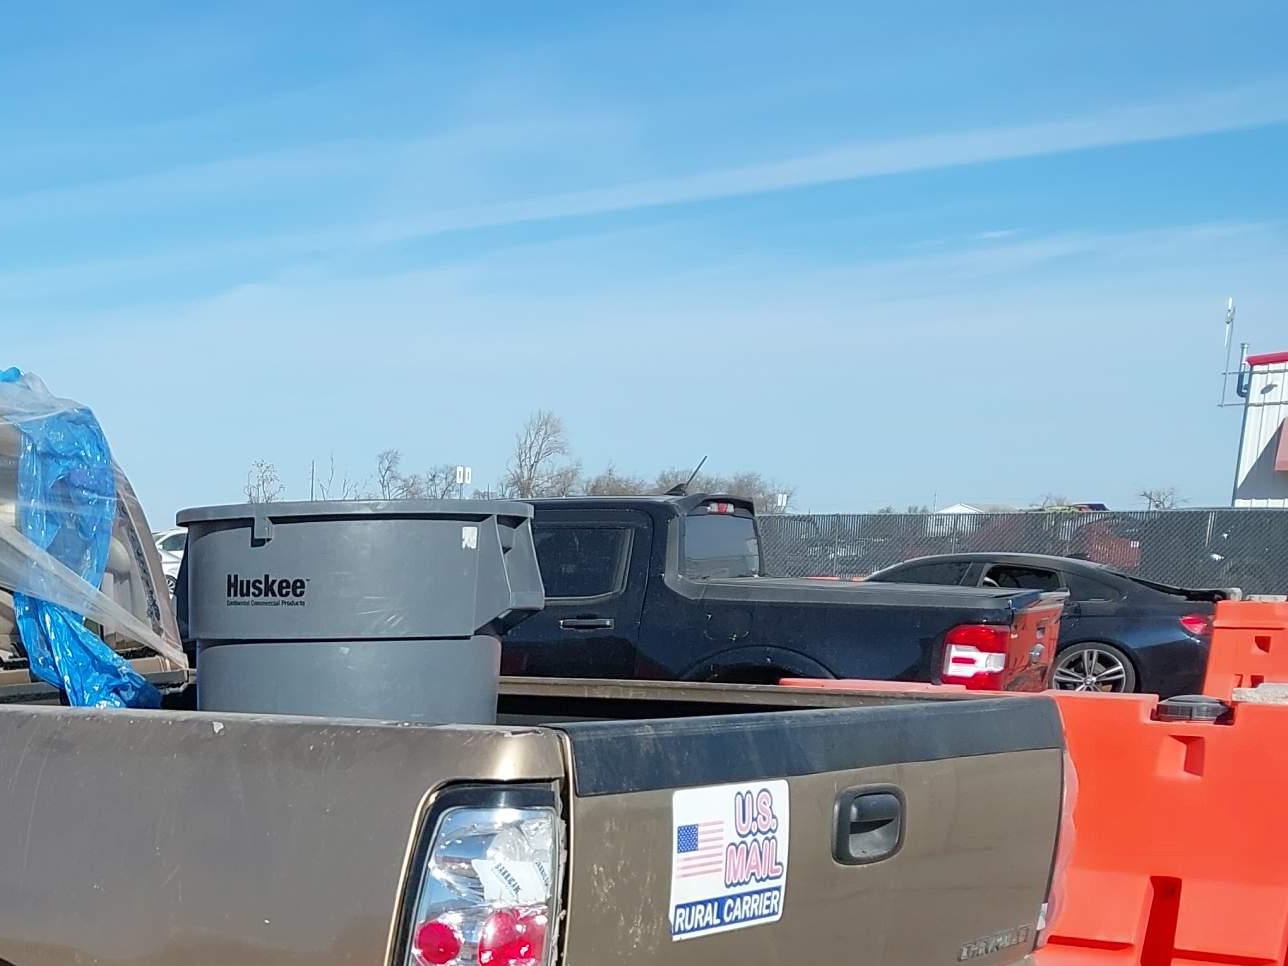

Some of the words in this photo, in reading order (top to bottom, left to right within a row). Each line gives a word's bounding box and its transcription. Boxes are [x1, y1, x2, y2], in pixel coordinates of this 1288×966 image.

[226, 573, 306, 598] Huskee
[735, 789, 778, 837] U.S.
[725, 836, 783, 888] MAIL
[675, 902, 721, 933] RURAL
[723, 890, 780, 923] CARRIER
